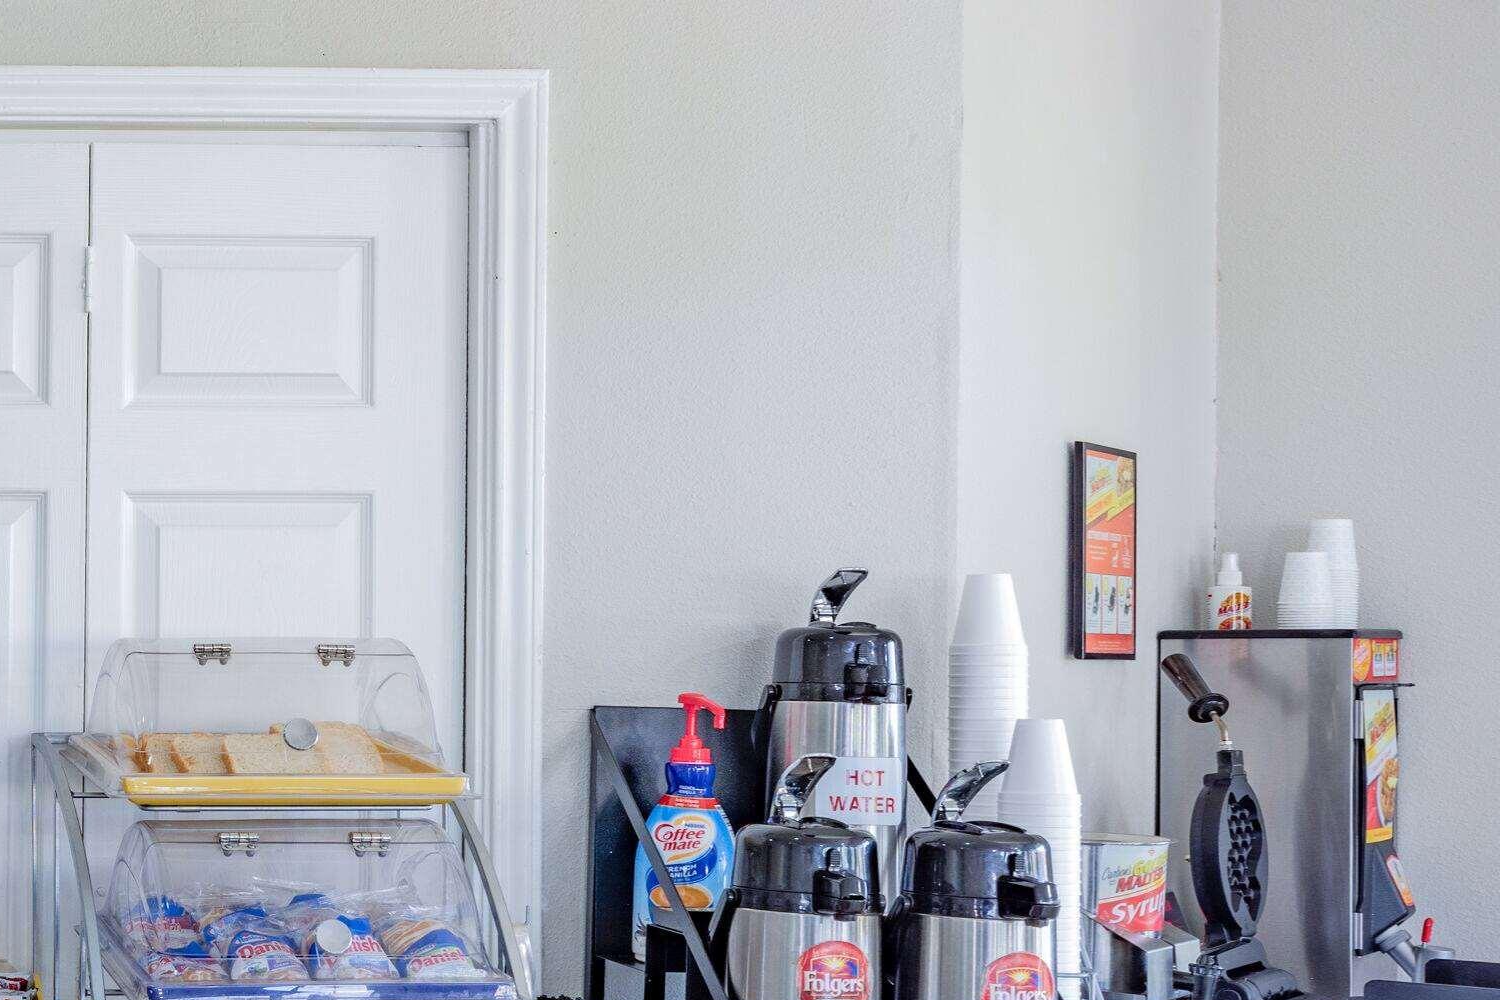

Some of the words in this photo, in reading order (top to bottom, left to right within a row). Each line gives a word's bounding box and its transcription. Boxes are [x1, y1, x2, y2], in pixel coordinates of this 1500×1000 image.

[846, 769, 885, 786] HOT
[829, 795, 896, 813] WATER
[654, 823, 706, 844] Coffee
[662, 838, 701, 852] mate
[669, 869, 698, 879] ANILLA
[803, 970, 865, 997] Folgers
